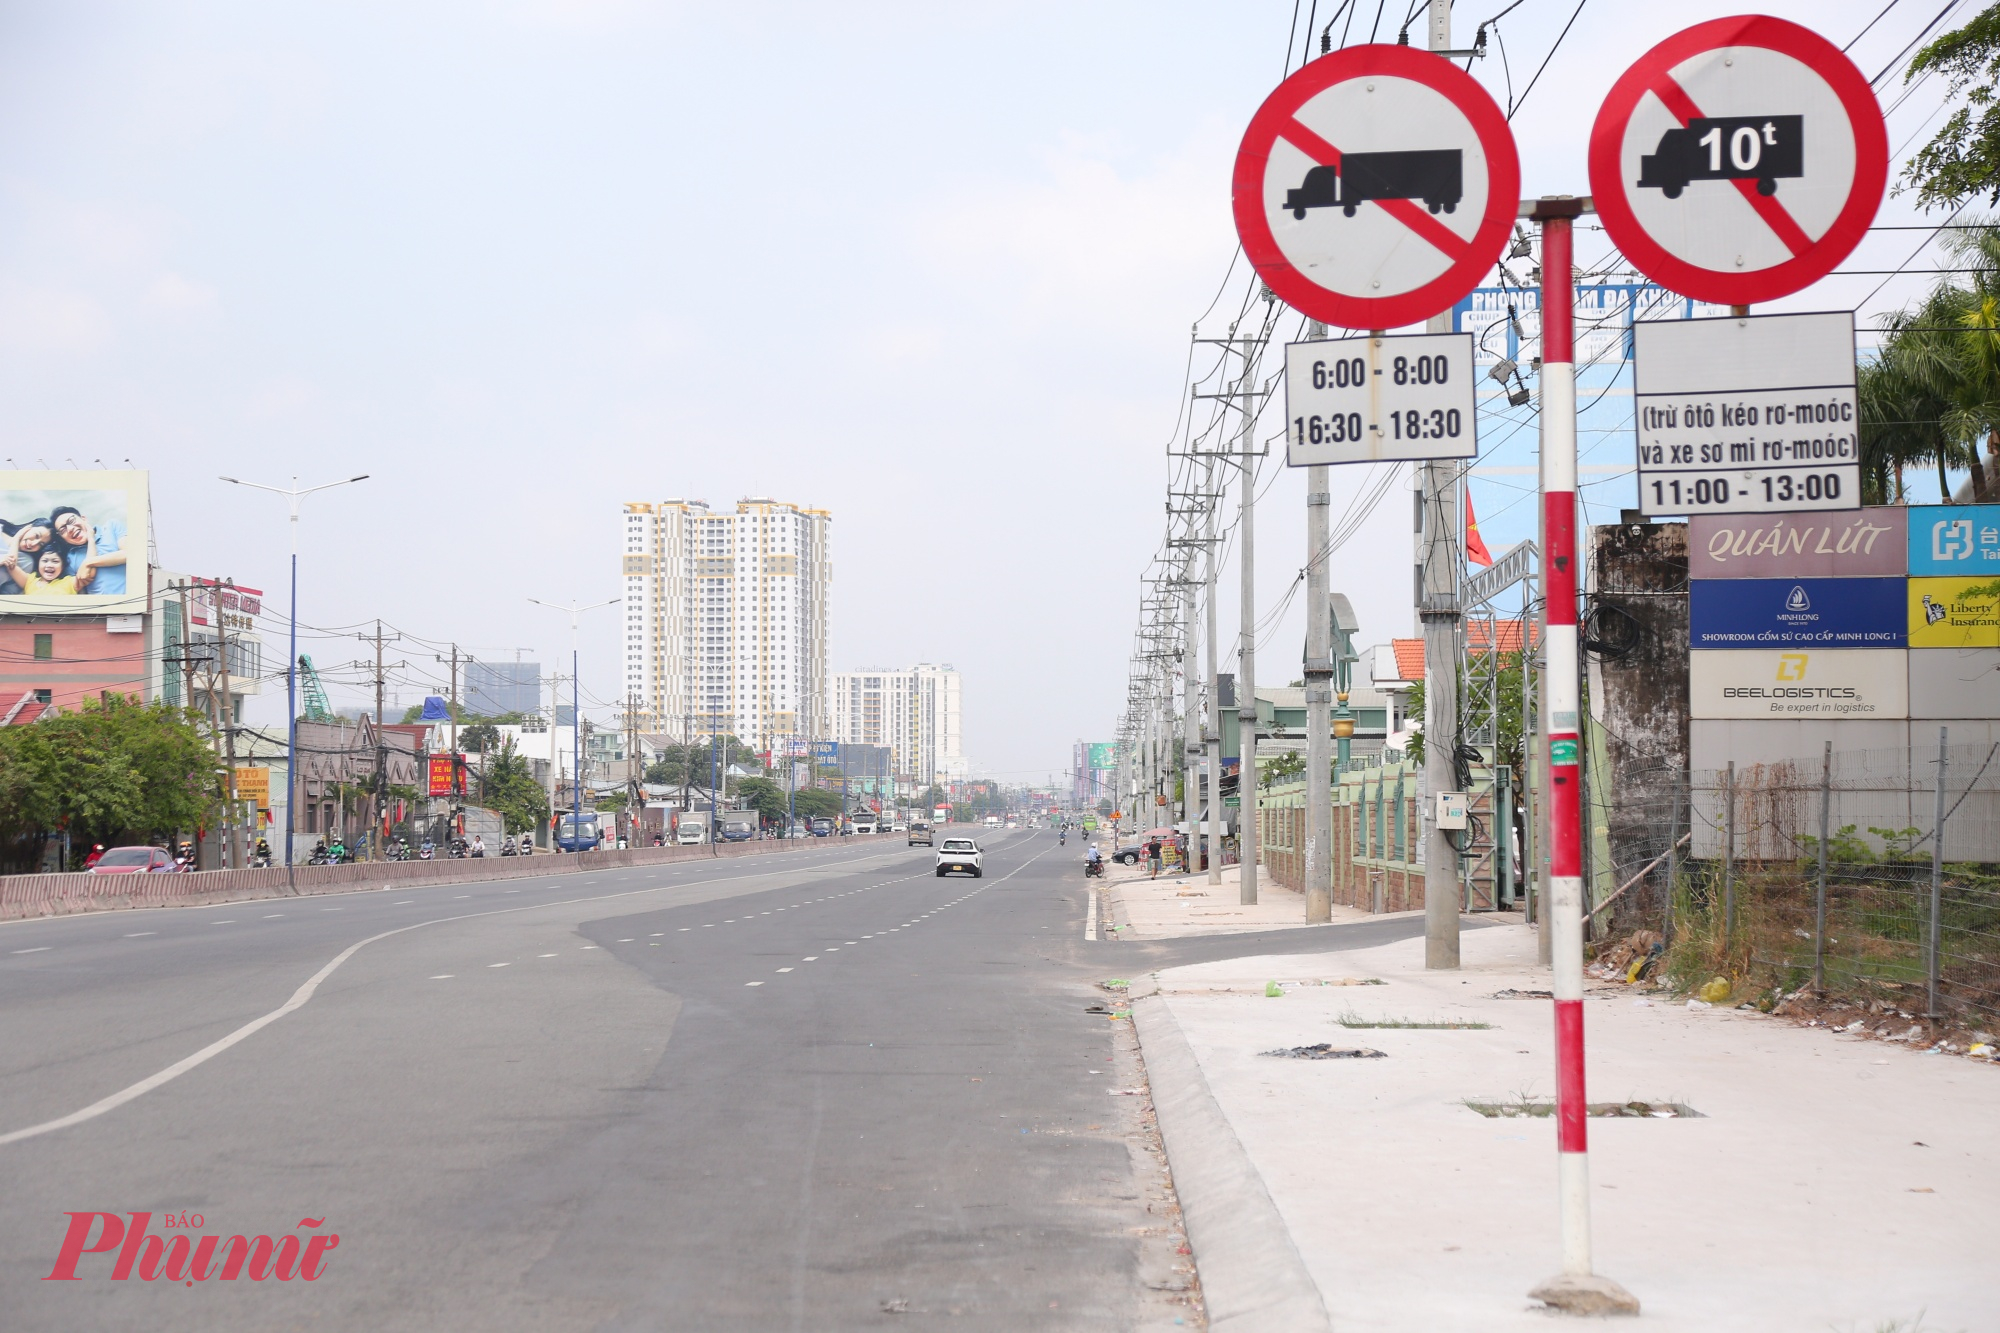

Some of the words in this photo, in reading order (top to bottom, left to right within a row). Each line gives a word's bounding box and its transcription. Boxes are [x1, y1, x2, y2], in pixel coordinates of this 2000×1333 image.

[1472, 287, 1537, 309] PHÒNG
[1312, 358, 1365, 390] 6:00
[1393, 354, 1449, 386] 8:00
[1294, 412, 1363, 446] 16:30
[1390, 408, 1462, 440] 18:30
[1643, 404, 1678, 432] (trừ
[1684, 402, 1715, 429] ôtô
[1722, 402, 1759, 427] kéo
[1766, 398, 1853, 425] rơ-moóc
[1641, 440, 1664, 465] và
[1670, 443, 1694, 464] xe
[1701, 441, 1724, 463] sơ
[1730, 437, 1756, 462] mi
[1763, 432, 1858, 461] rơ-moóc)
[1651, 478, 1730, 506] 11:00
[1761, 473, 1842, 502] 13:00
[1708, 520, 1814, 562] QUÁN
[1950, 603, 1992, 615] Liberty
[1702, 633, 1755, 641] SHOWROOM
[1757, 630, 1780, 641] GỐM
[1781, 631, 1794, 641] SỨ
[1794, 633, 1814, 641] CAO
[1815, 630, 1834, 641] CẤP
[1835, 633, 1862, 641] MINH
[1864, 633, 1891, 641] LONG
[1723, 687, 1856, 698] BEELOGISTICS
[1770, 703, 1785, 712] Be
[1787, 704, 1819, 714] expert
[1821, 703, 1831, 712] in
[1834, 702, 1875, 714] logistics
